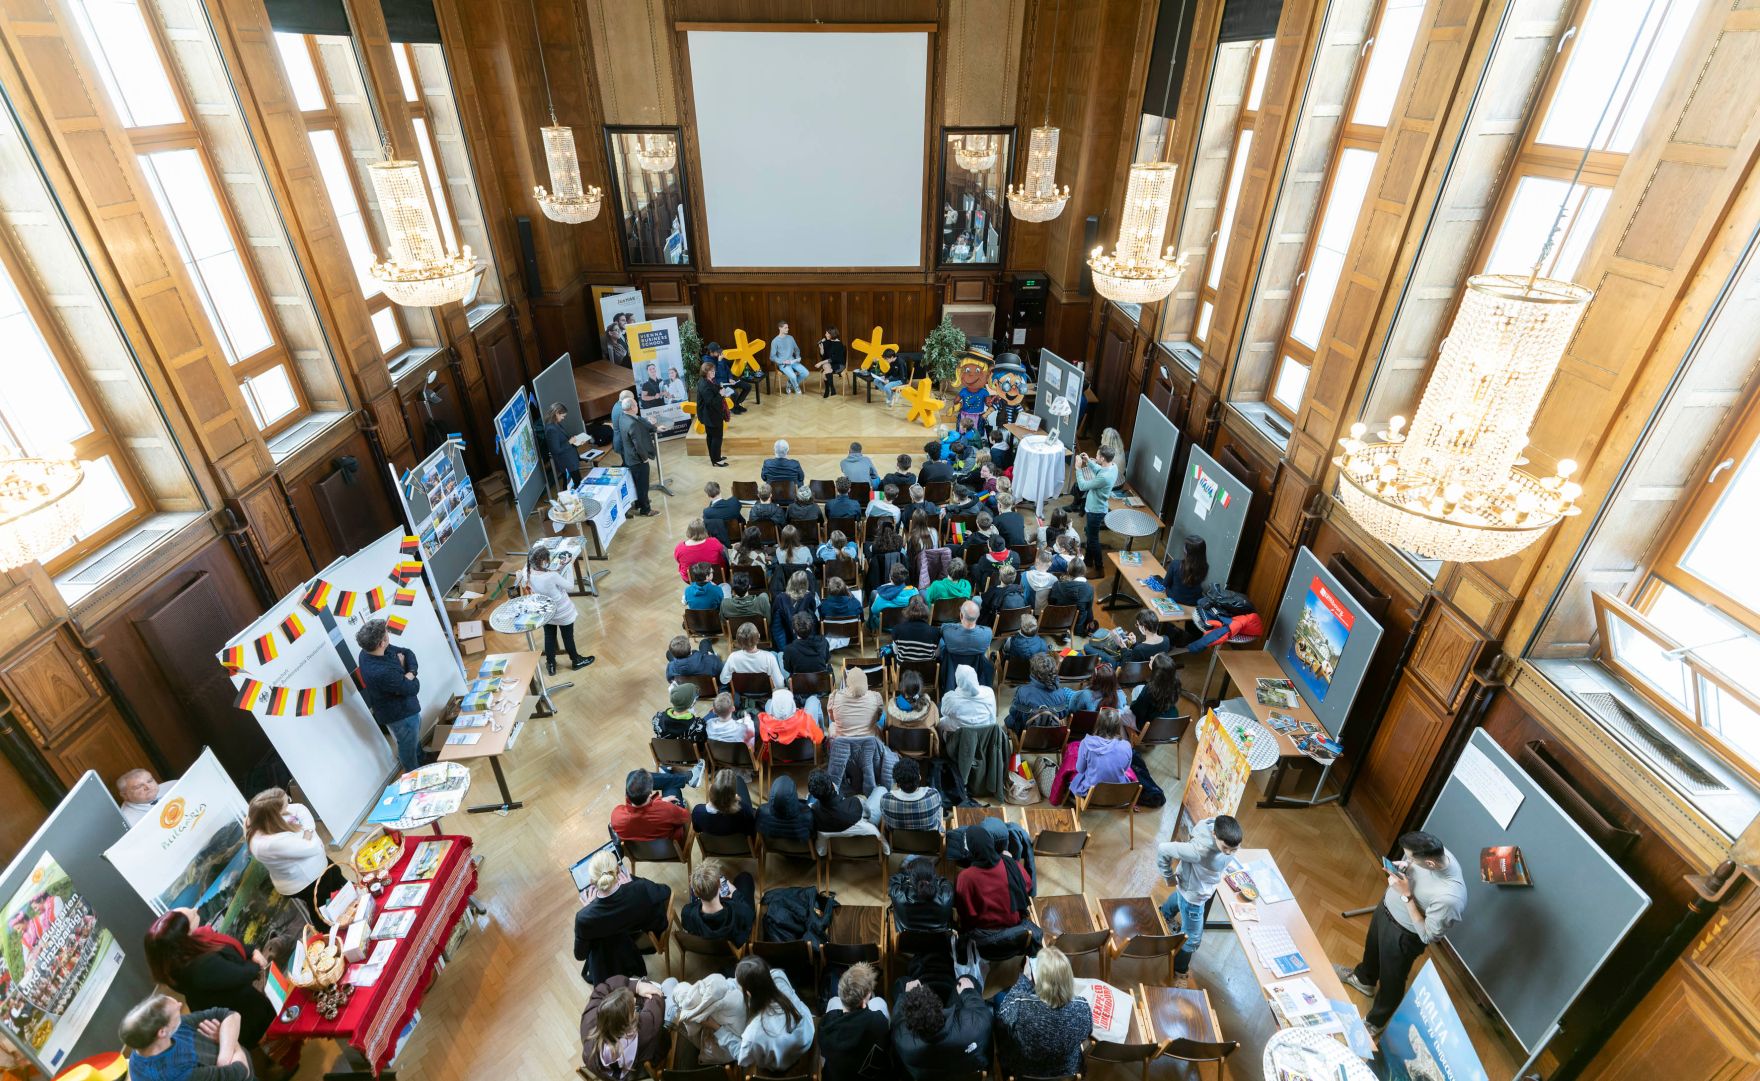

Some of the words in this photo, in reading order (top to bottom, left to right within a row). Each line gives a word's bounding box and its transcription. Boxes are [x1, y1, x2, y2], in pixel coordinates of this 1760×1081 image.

[640, 331, 663, 339] VIENNA
[640, 334, 668, 342] BUSINESS
[641, 340, 664, 348] SCHOOL
[41, 892, 79, 943] Bulgarien
[22, 970, 41, 996] und
[40, 908, 84, 970] einzigartig!
[1419, 985, 1448, 1046] MALTA
